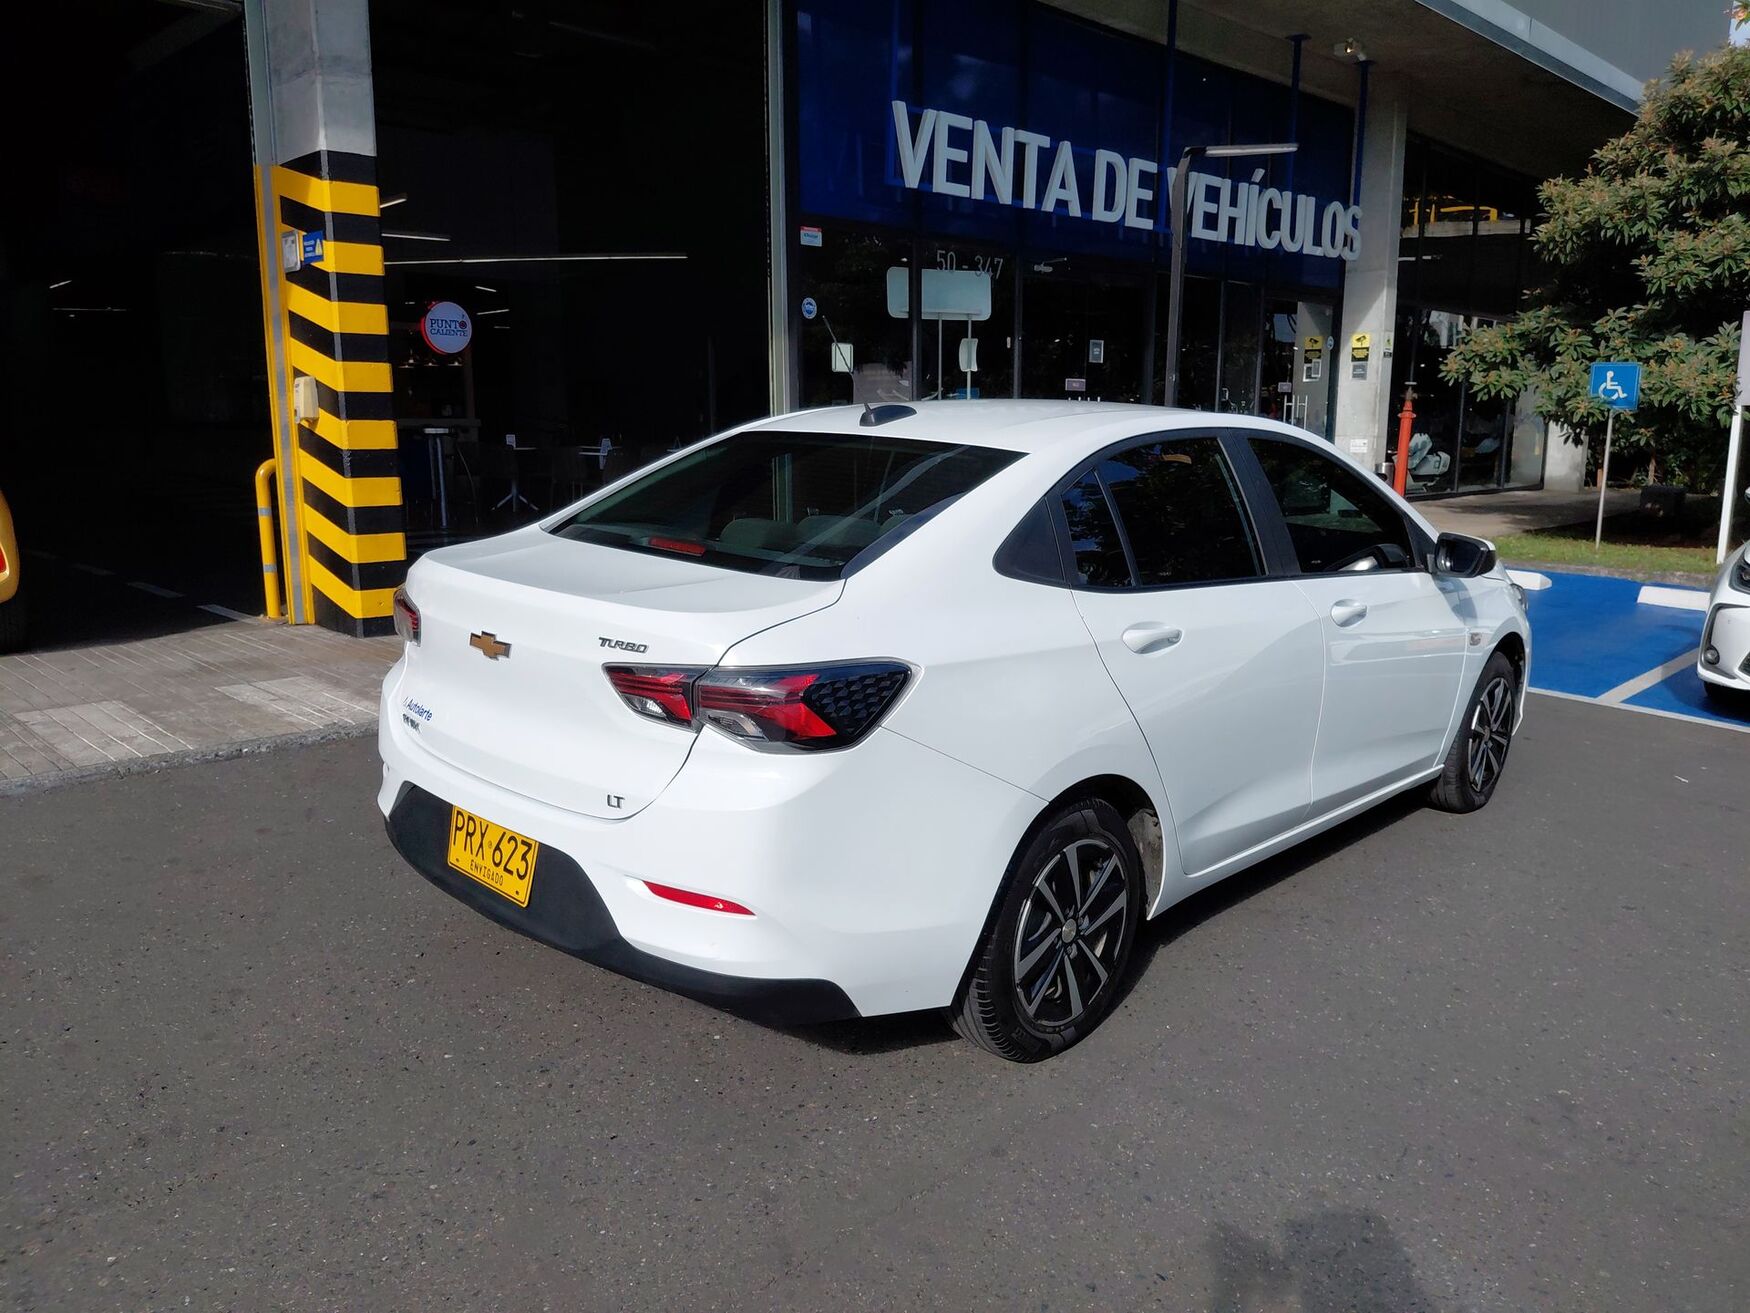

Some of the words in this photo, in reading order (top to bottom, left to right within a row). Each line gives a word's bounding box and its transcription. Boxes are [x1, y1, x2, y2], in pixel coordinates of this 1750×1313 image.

[891, 100, 1082, 218] VENTA
[1092, 149, 1158, 230] DE
[936, 249, 957, 272] 50
[429, 318, 468, 330] PUNTO
[430, 328, 469, 337] CALIENTE
[598, 637, 649, 654] TURBO
[606, 793, 625, 809] LT
[452, 810, 490, 861] PRX
[490, 831, 530, 881] 623
[469, 858, 505, 887] ENVIGADO
